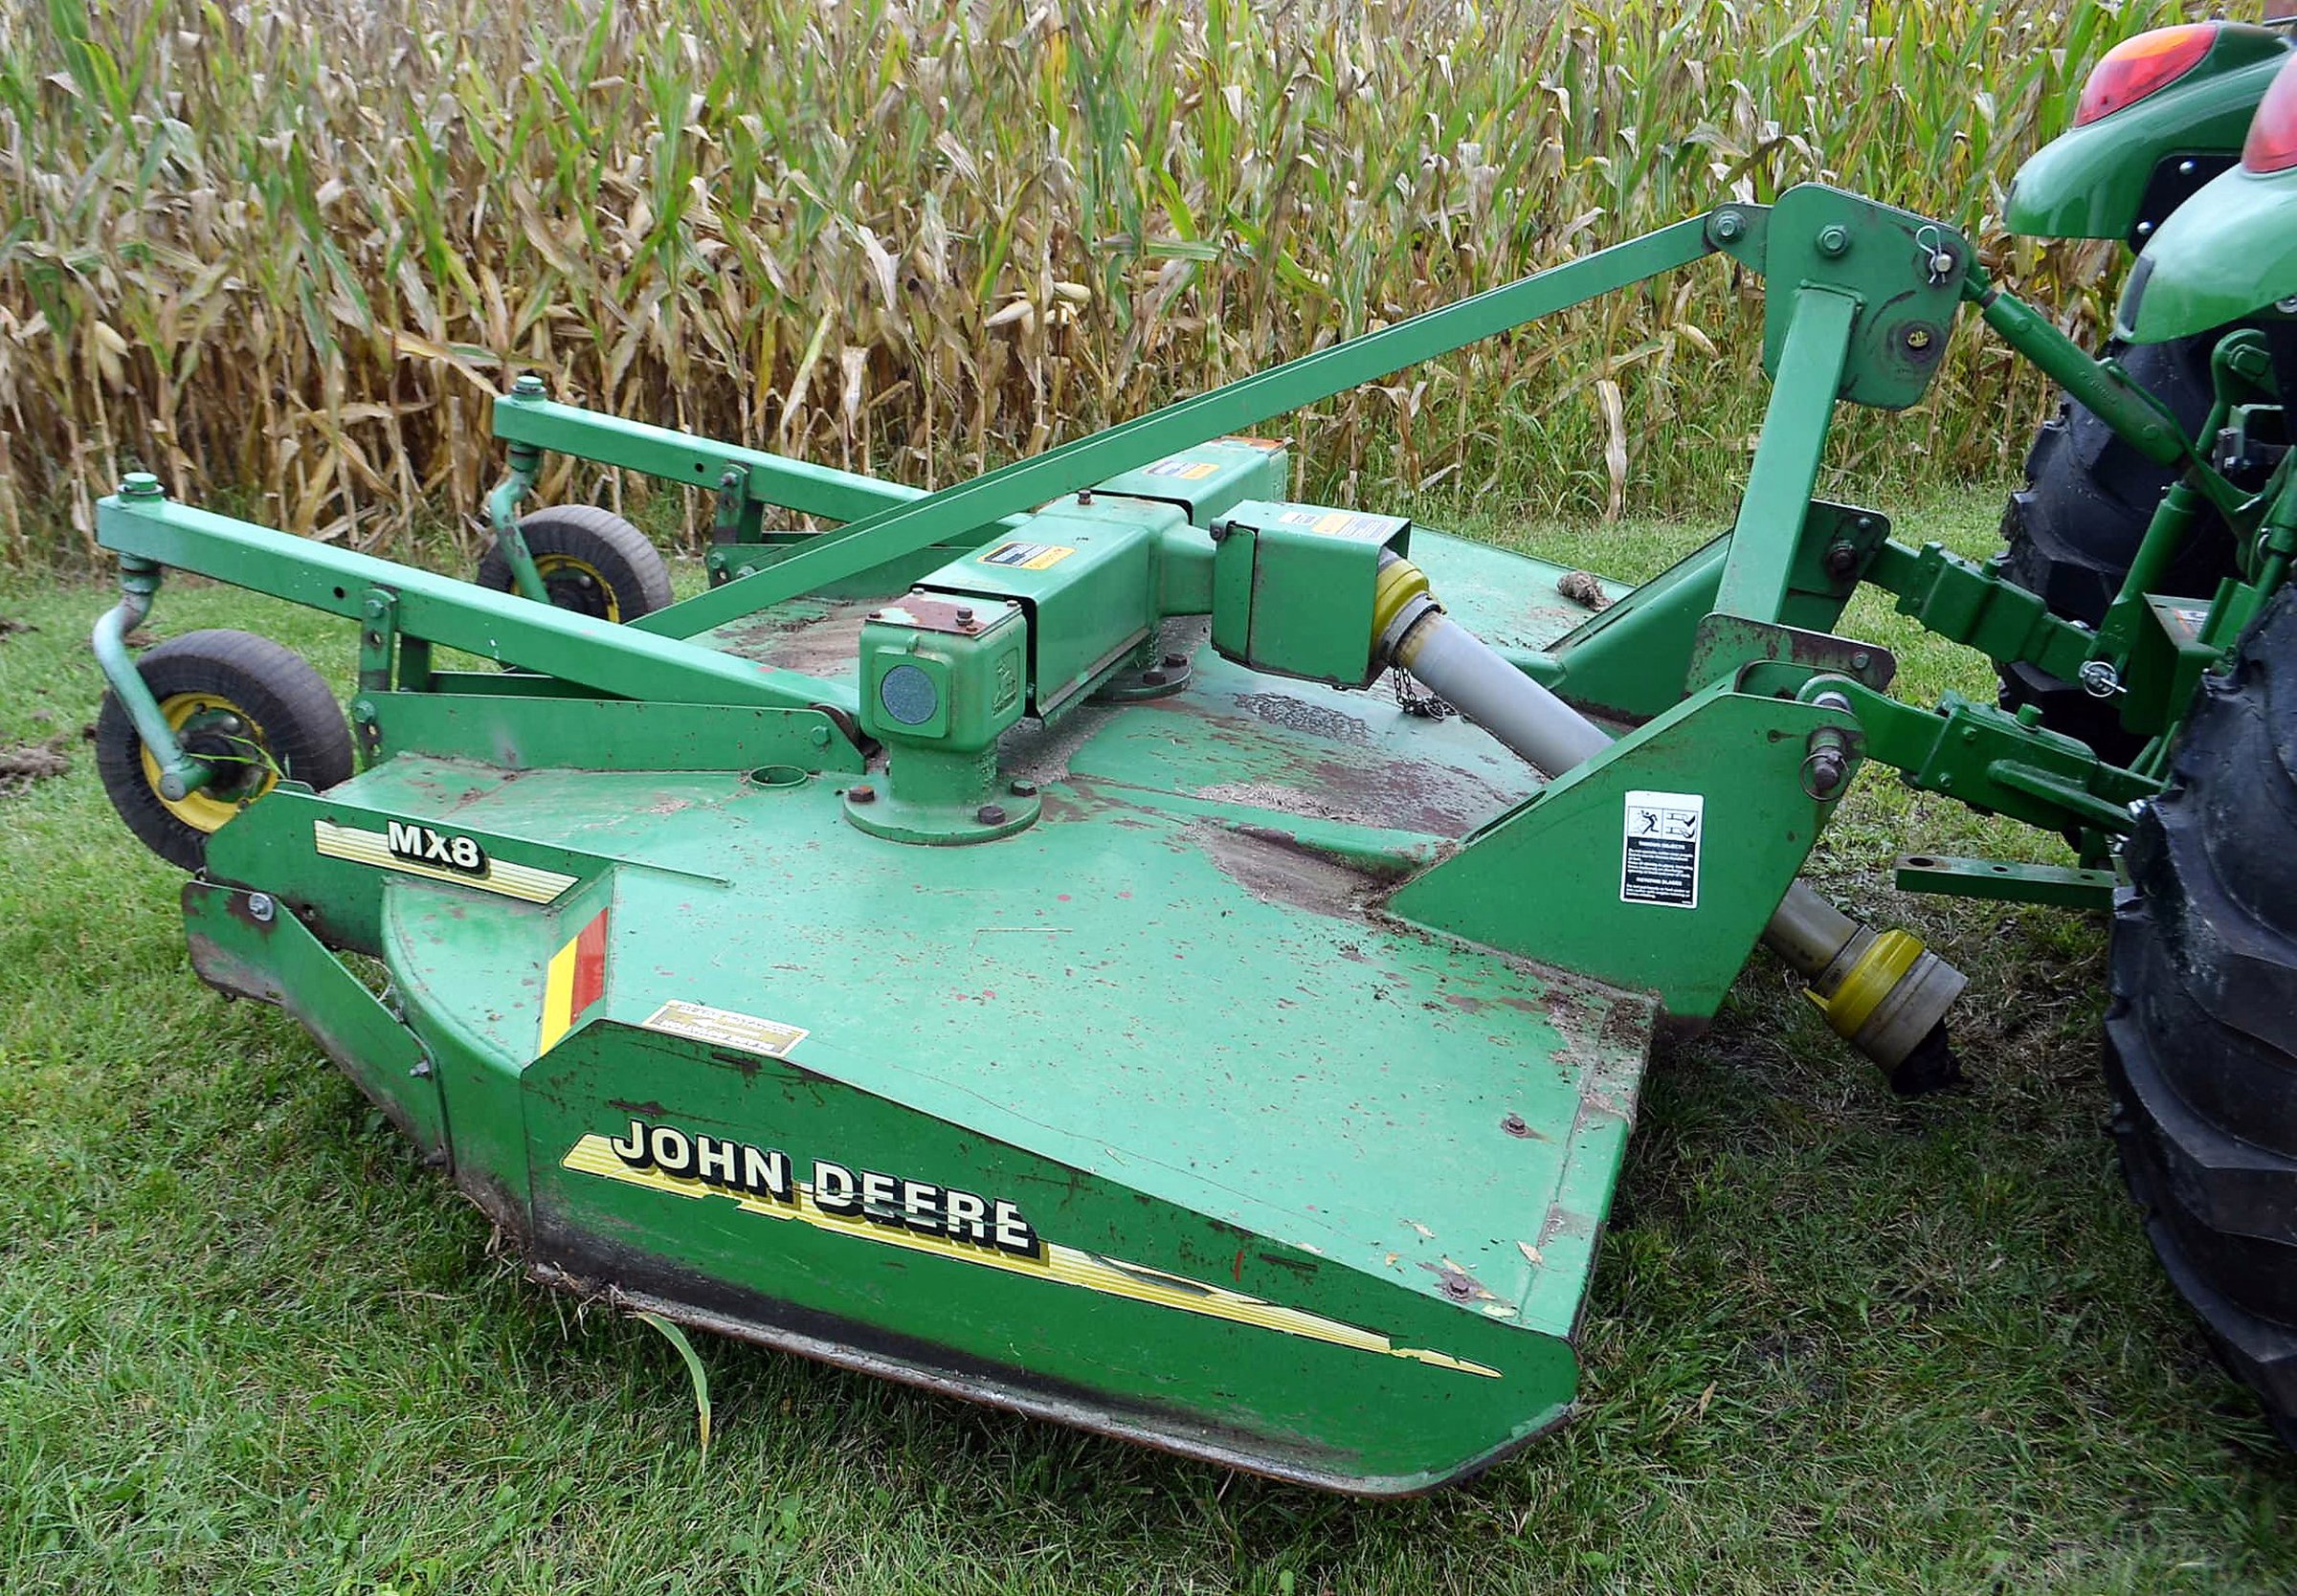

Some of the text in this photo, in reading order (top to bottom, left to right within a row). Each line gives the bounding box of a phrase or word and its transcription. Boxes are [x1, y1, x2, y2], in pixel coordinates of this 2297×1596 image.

[387, 819, 482, 870] MX8
[611, 1119, 1034, 1251] JOHN DEERE
